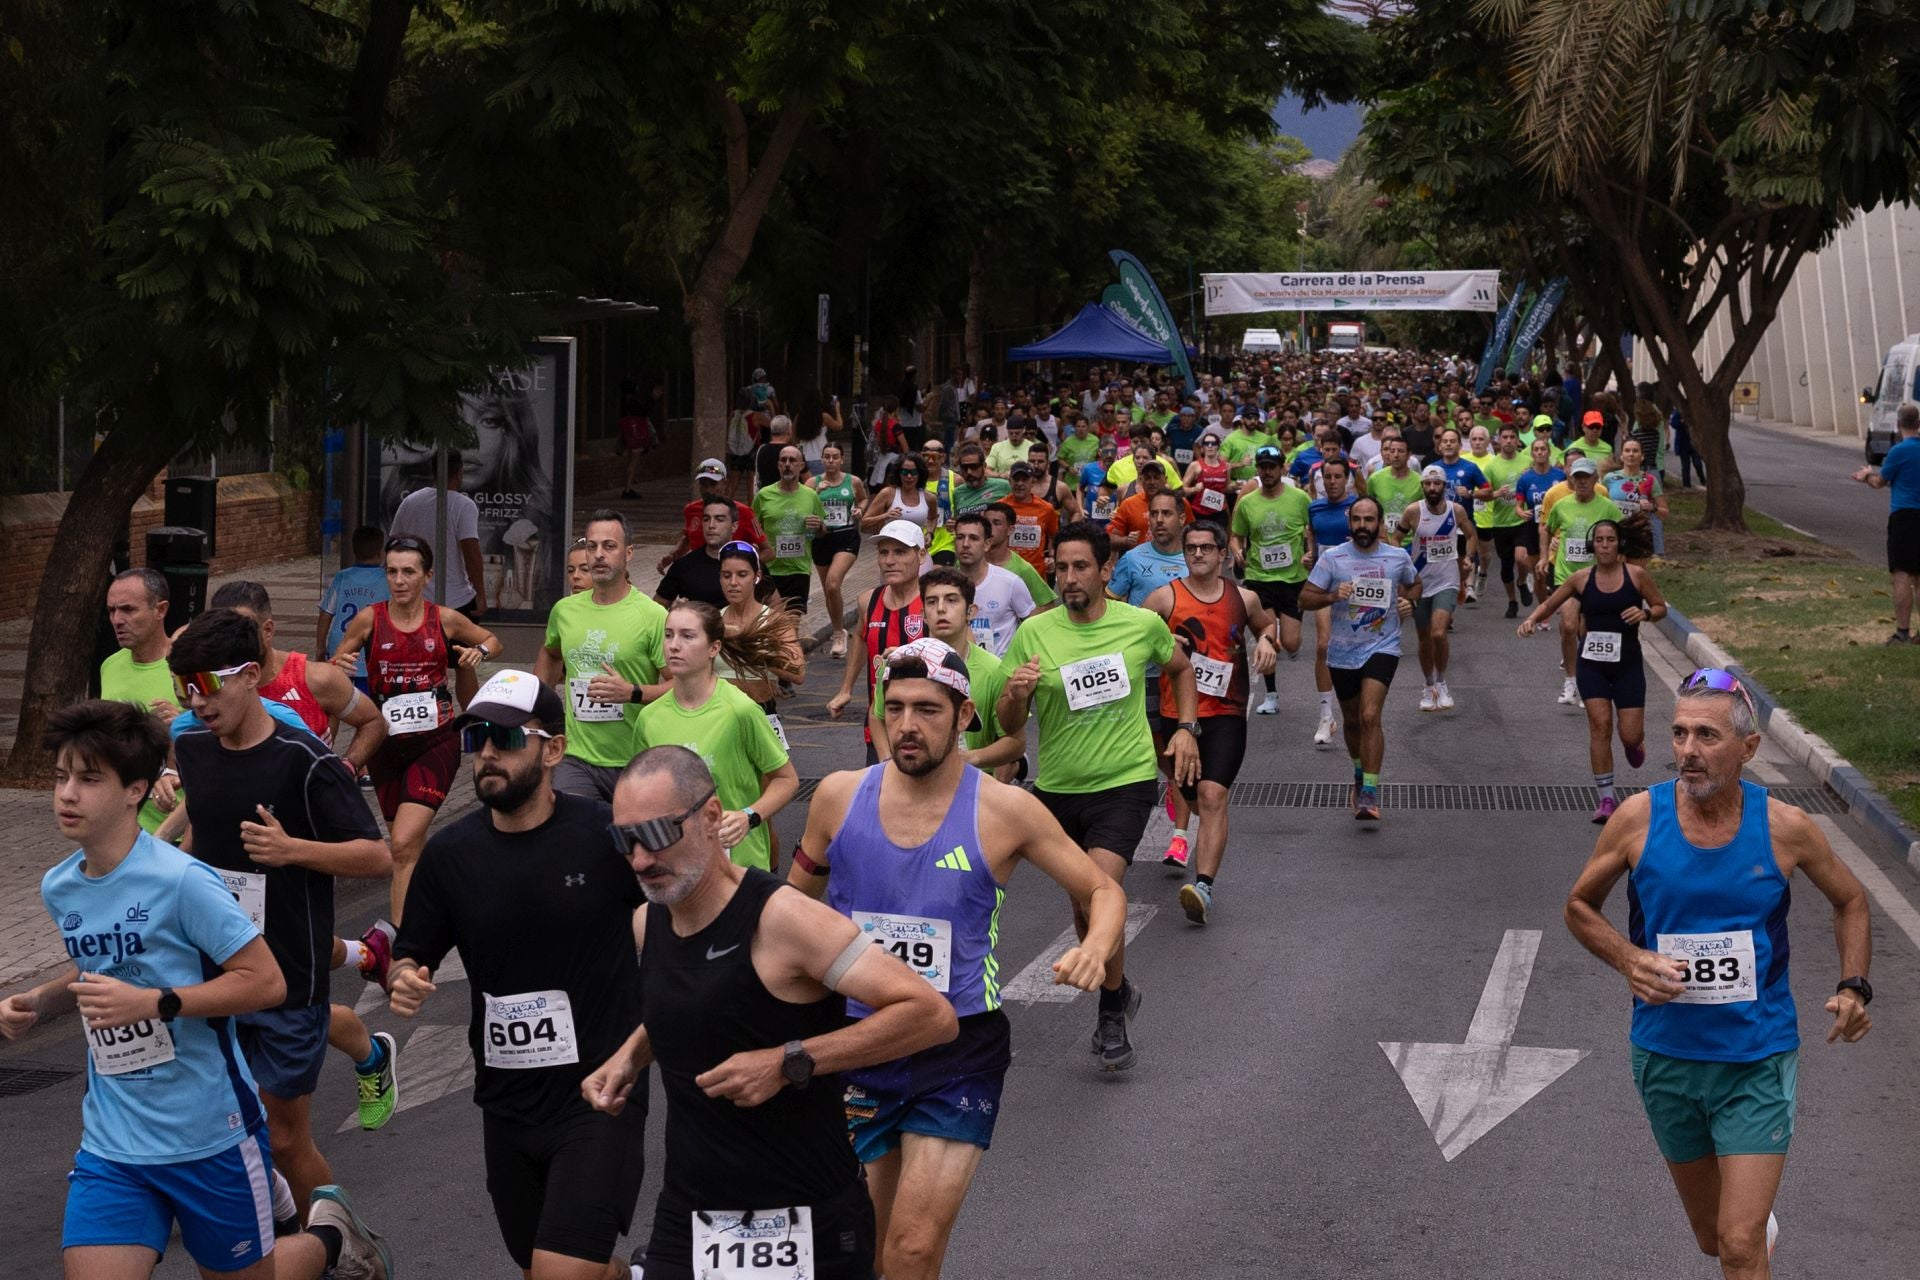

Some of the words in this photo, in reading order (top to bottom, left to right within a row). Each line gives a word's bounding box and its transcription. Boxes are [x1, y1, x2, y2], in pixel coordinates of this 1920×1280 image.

[1280, 275, 1334, 287] Carrera
[1338, 274, 1356, 286] de
[1360, 274, 1372, 286] la
[1376, 274, 1425, 286] Prensa
[1375, 288, 1408, 296] Libertad
[1419, 288, 1446, 296] Prensa
[473, 492, 532, 505] GLOSSY
[1204, 495, 1223, 506] 404
[1013, 532, 1037, 542] 650
[780, 542, 801, 552] 605
[1430, 546, 1453, 557] 940
[1264, 551, 1288, 563] 873
[1356, 586, 1385, 600] 509
[1587, 641, 1614, 654] 259
[1070, 668, 1120, 692] 1025
[1194, 666, 1224, 687] 871
[390, 706, 429, 723] 548
[63, 923, 147, 964] nerja
[874, 939, 934, 968] 49
[90, 1018, 154, 1048] 1030
[489, 1016, 558, 1048] 604
[704, 1240, 799, 1269] 1183
